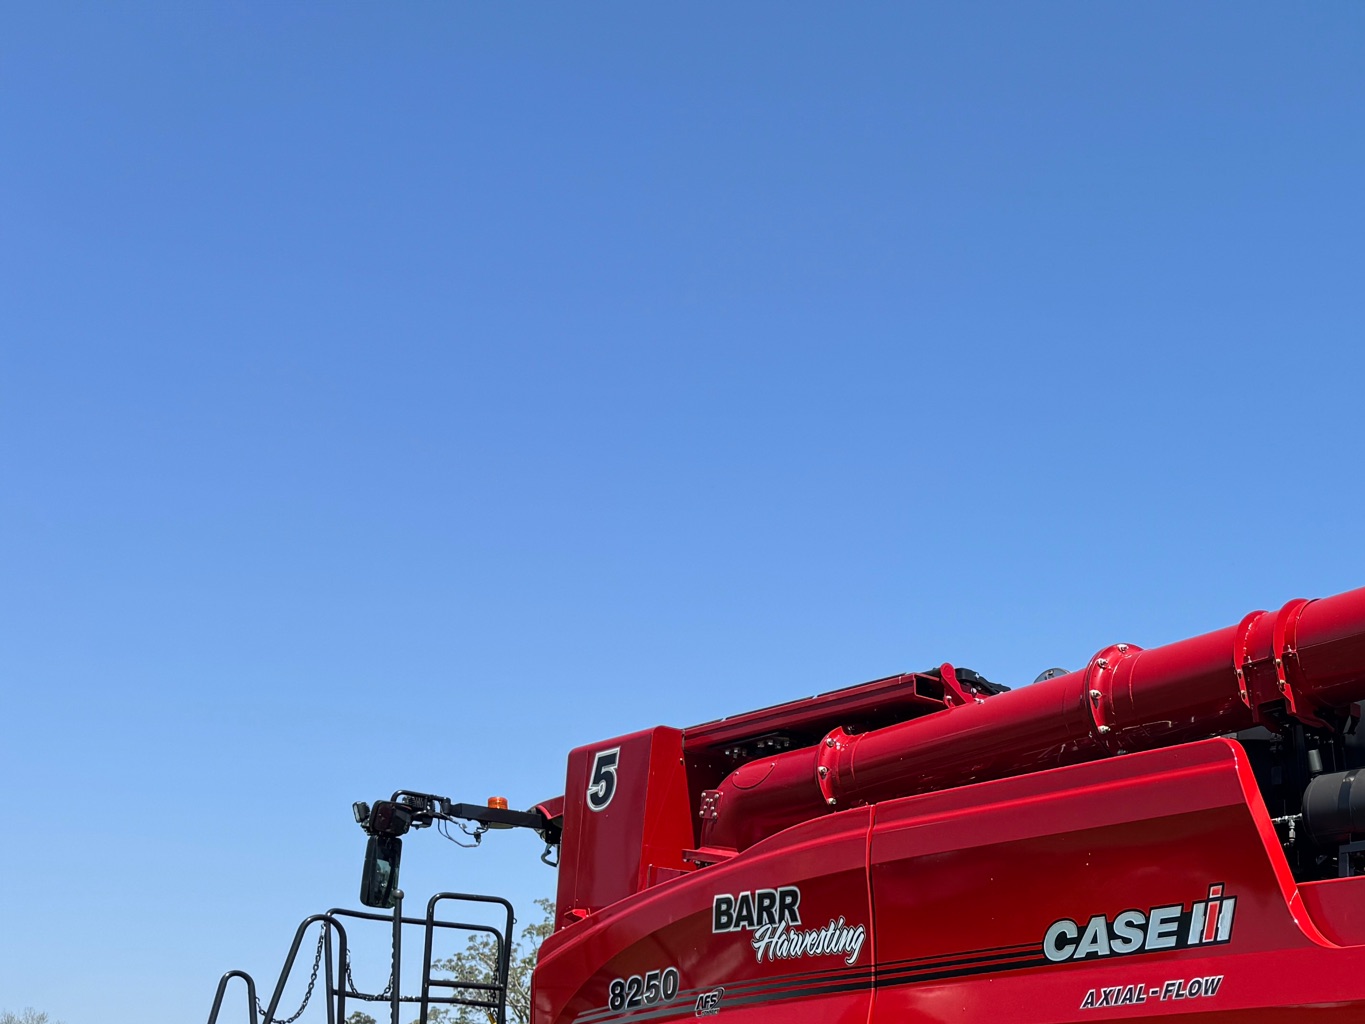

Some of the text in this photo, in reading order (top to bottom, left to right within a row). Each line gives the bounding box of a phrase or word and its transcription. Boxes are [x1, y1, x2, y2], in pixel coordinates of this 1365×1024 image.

[586, 746, 621, 812] 5
[712, 886, 801, 933] BARR
[752, 916, 865, 965] Harvesting
[1043, 905, 1183, 962] CASE
[608, 966, 680, 1012] 8250
[695, 991, 719, 1011] AFS
[1080, 975, 1224, 1009] AXIAL-FLOW
